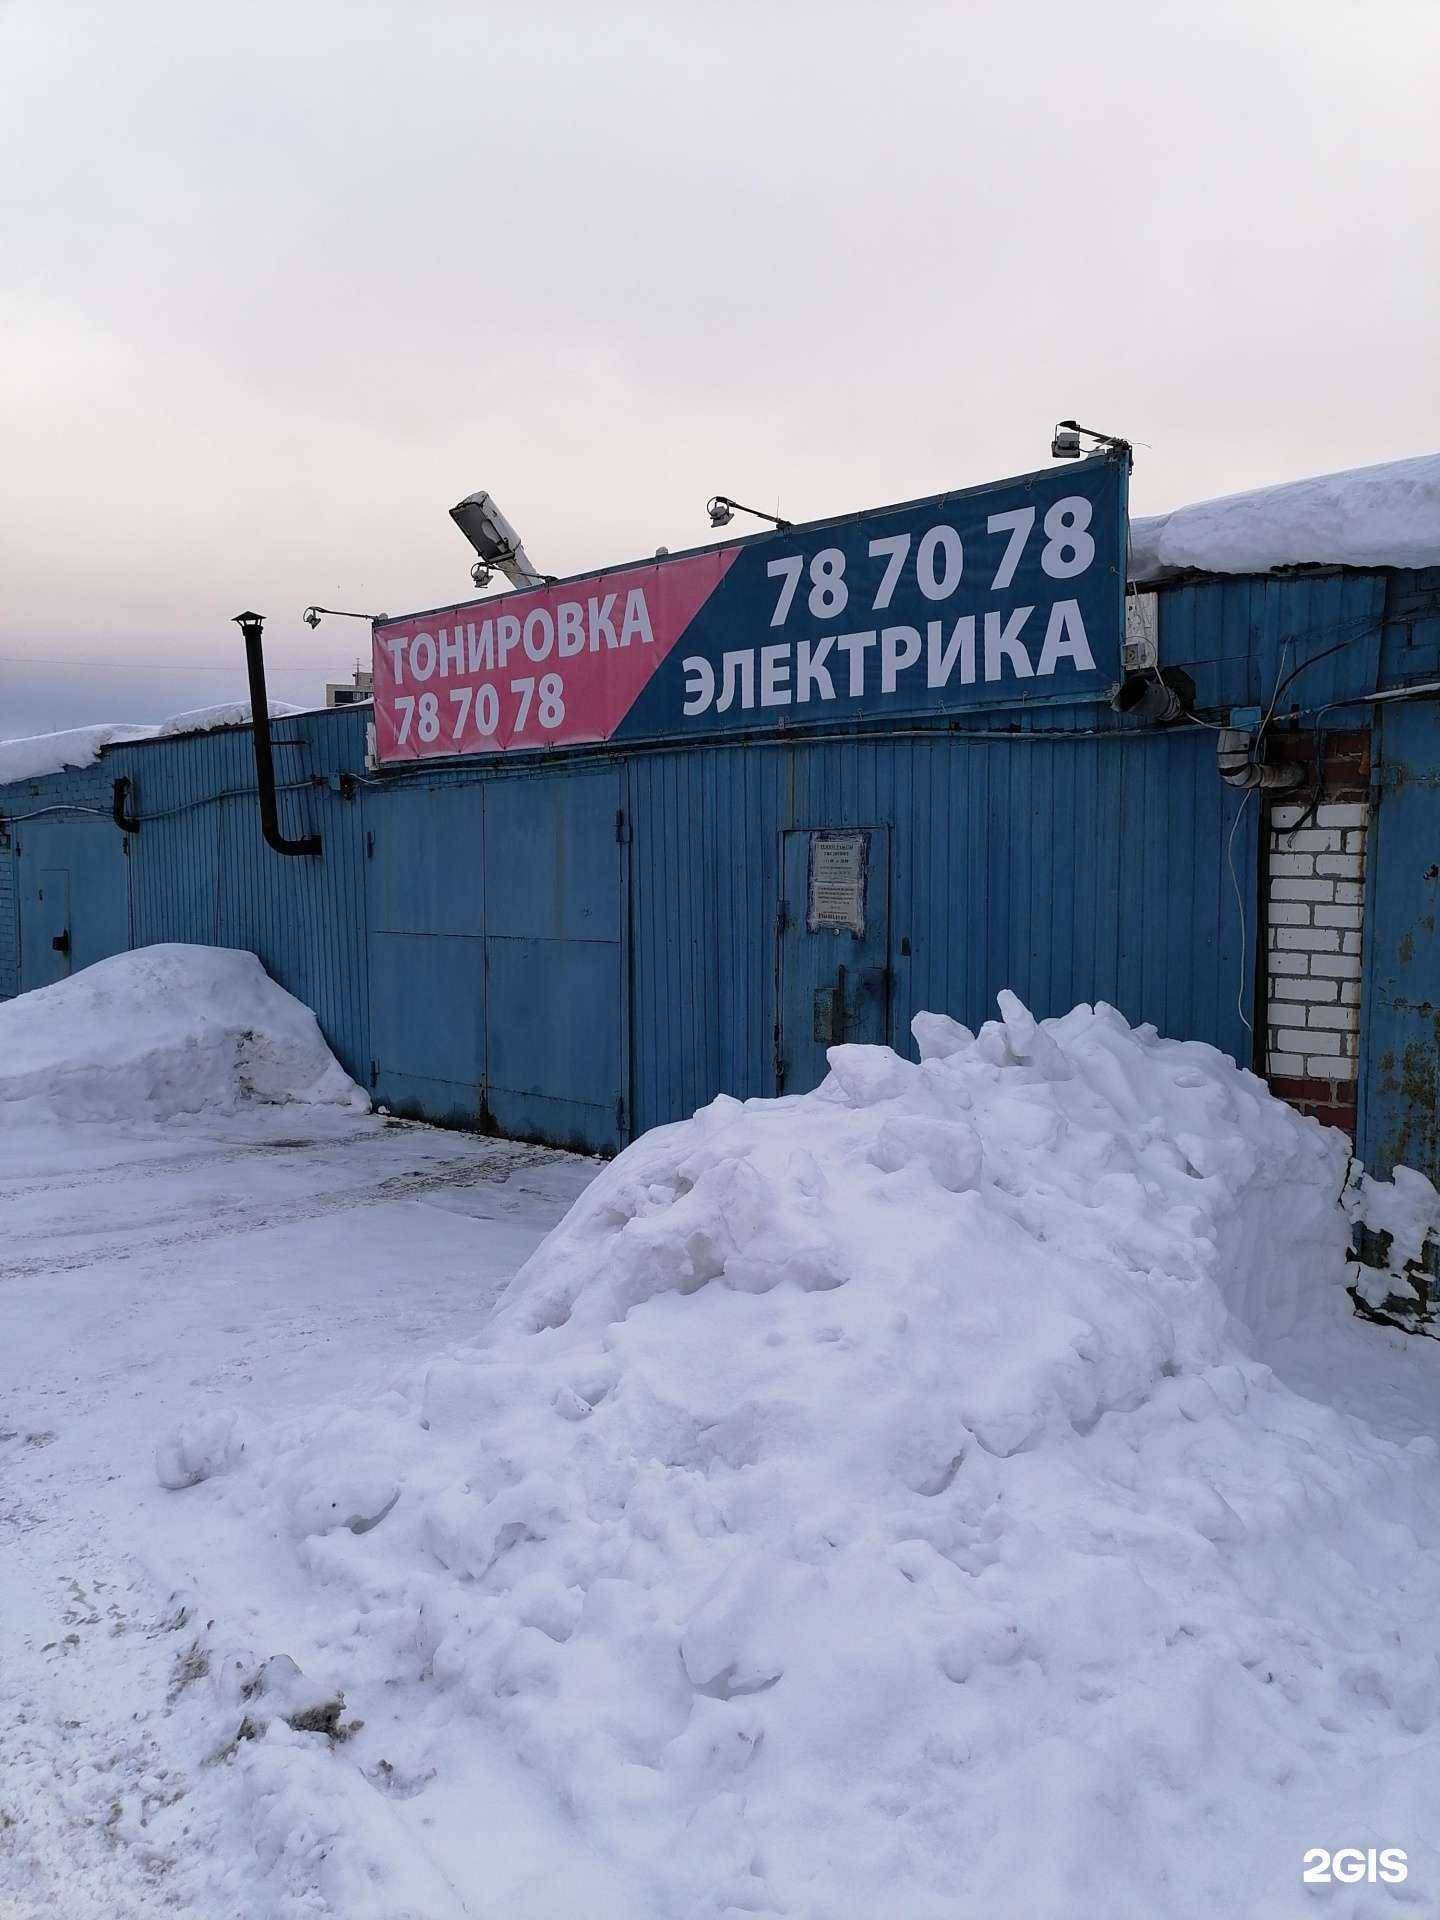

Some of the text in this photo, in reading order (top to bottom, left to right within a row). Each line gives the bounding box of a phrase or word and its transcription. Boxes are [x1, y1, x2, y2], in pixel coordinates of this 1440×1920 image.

[767, 495, 1096, 627] 78 70 78
[387, 587, 654, 685] ТОНИРОВКА
[682, 598, 1097, 716] ЭЛЕКТРИКА
[394, 672, 565, 745] 78 70 78
